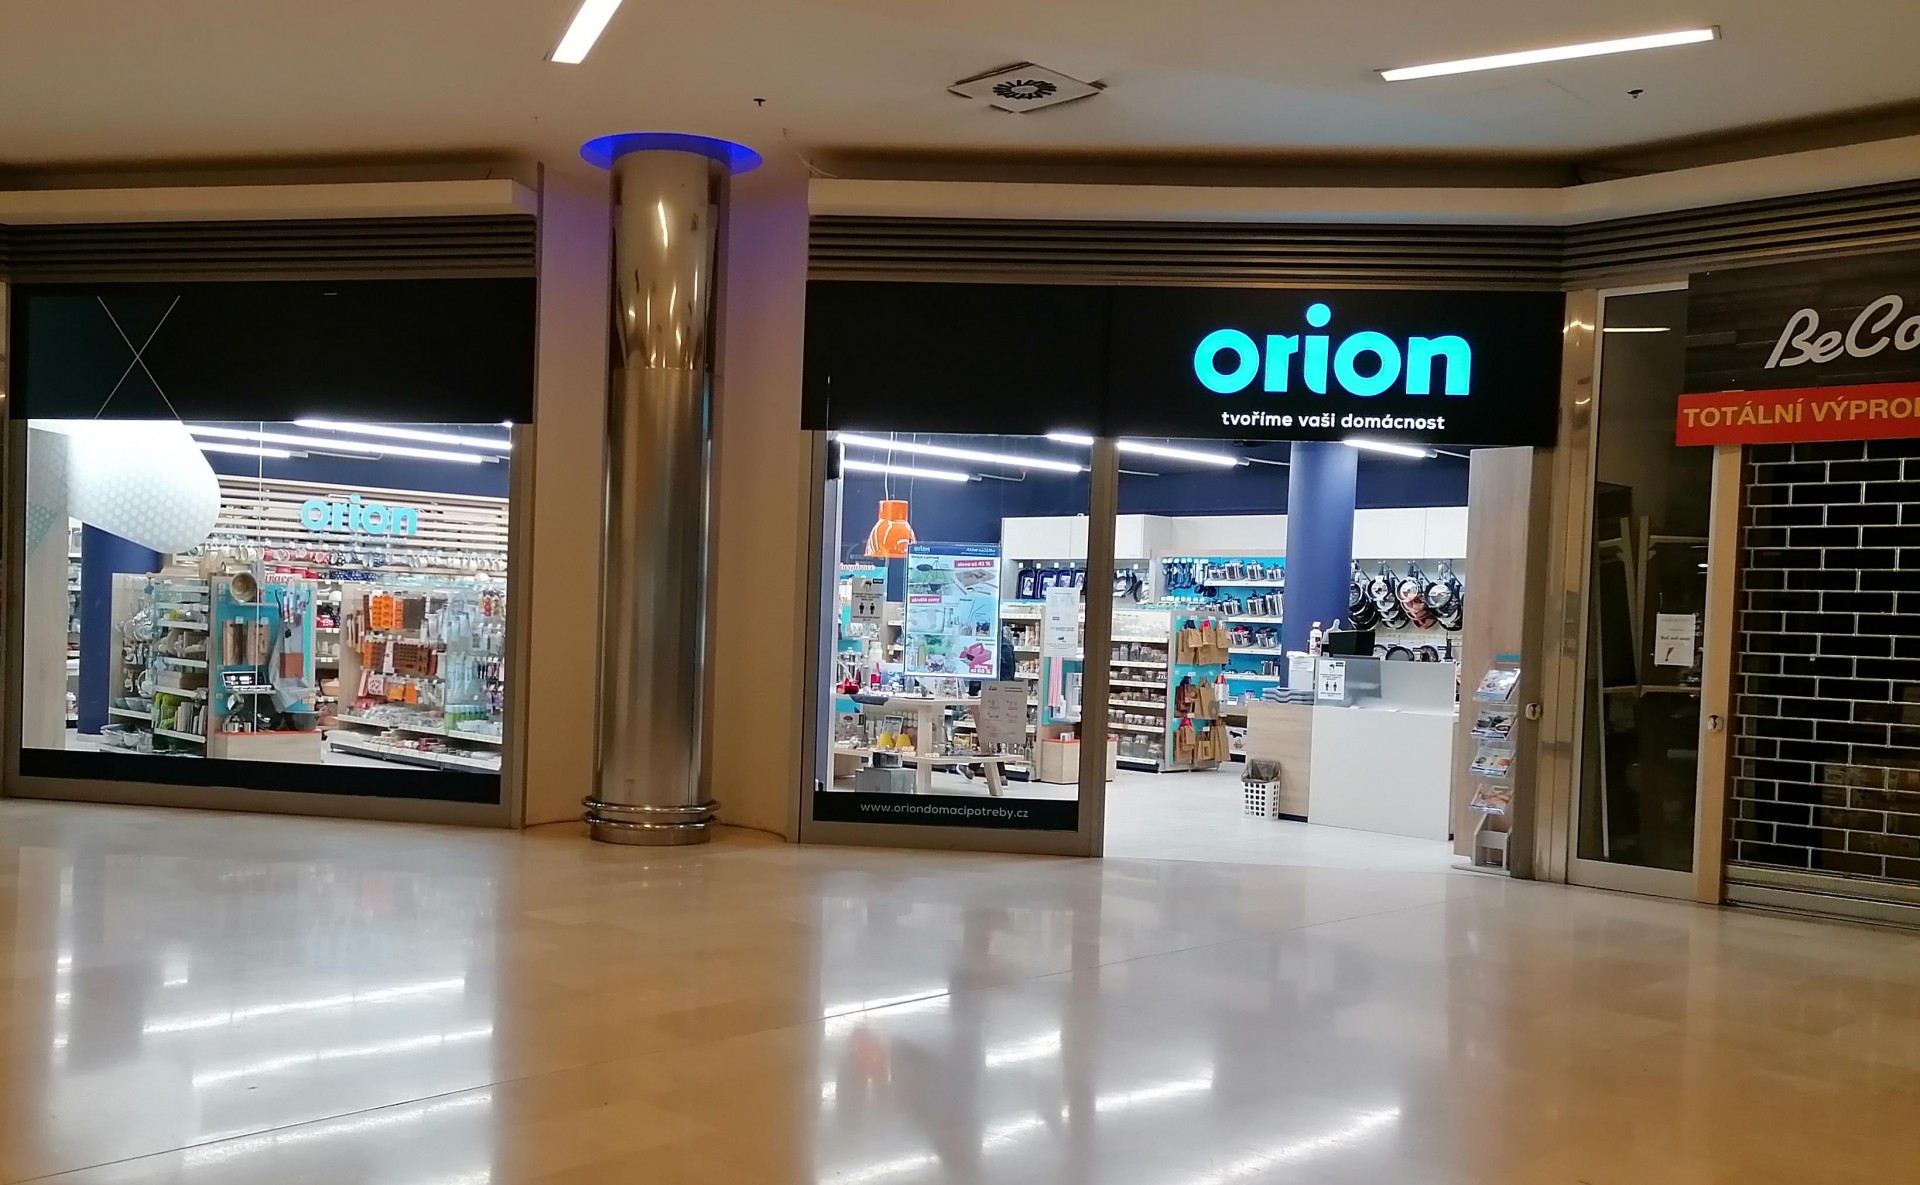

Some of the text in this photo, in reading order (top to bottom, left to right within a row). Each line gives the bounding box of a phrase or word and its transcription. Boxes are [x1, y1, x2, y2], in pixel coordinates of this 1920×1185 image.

[1194, 303, 1471, 396] orion
[1221, 411, 1446, 430] tvoříme vaši domácnost
[1683, 397, 1805, 428] TOTÁLNÍ
[301, 493, 418, 536] orion
[860, 803, 1029, 819] www.oriondomacipotreby.cz
